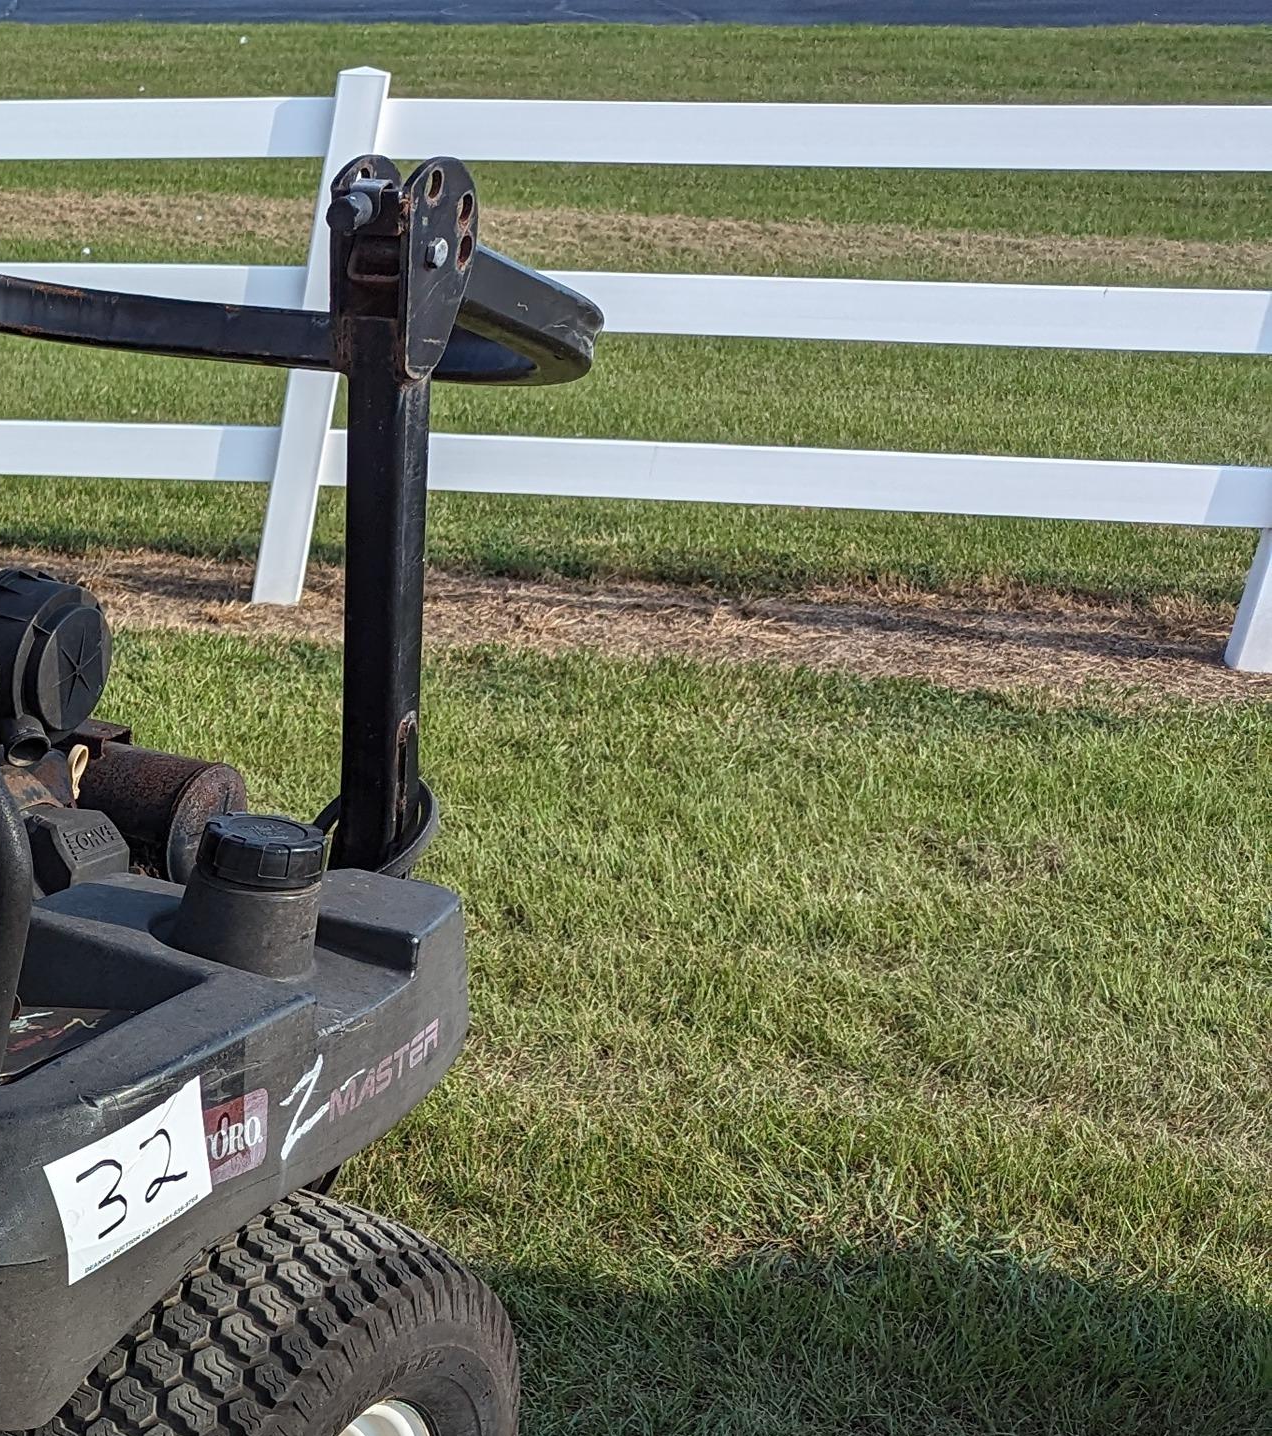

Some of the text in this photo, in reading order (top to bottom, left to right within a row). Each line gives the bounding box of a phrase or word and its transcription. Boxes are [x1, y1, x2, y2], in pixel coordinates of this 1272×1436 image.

[328, 1017, 440, 1123] MASTER
[75, 1127, 188, 1240] 32
[112, 1233, 141, 1257] AUCTION
